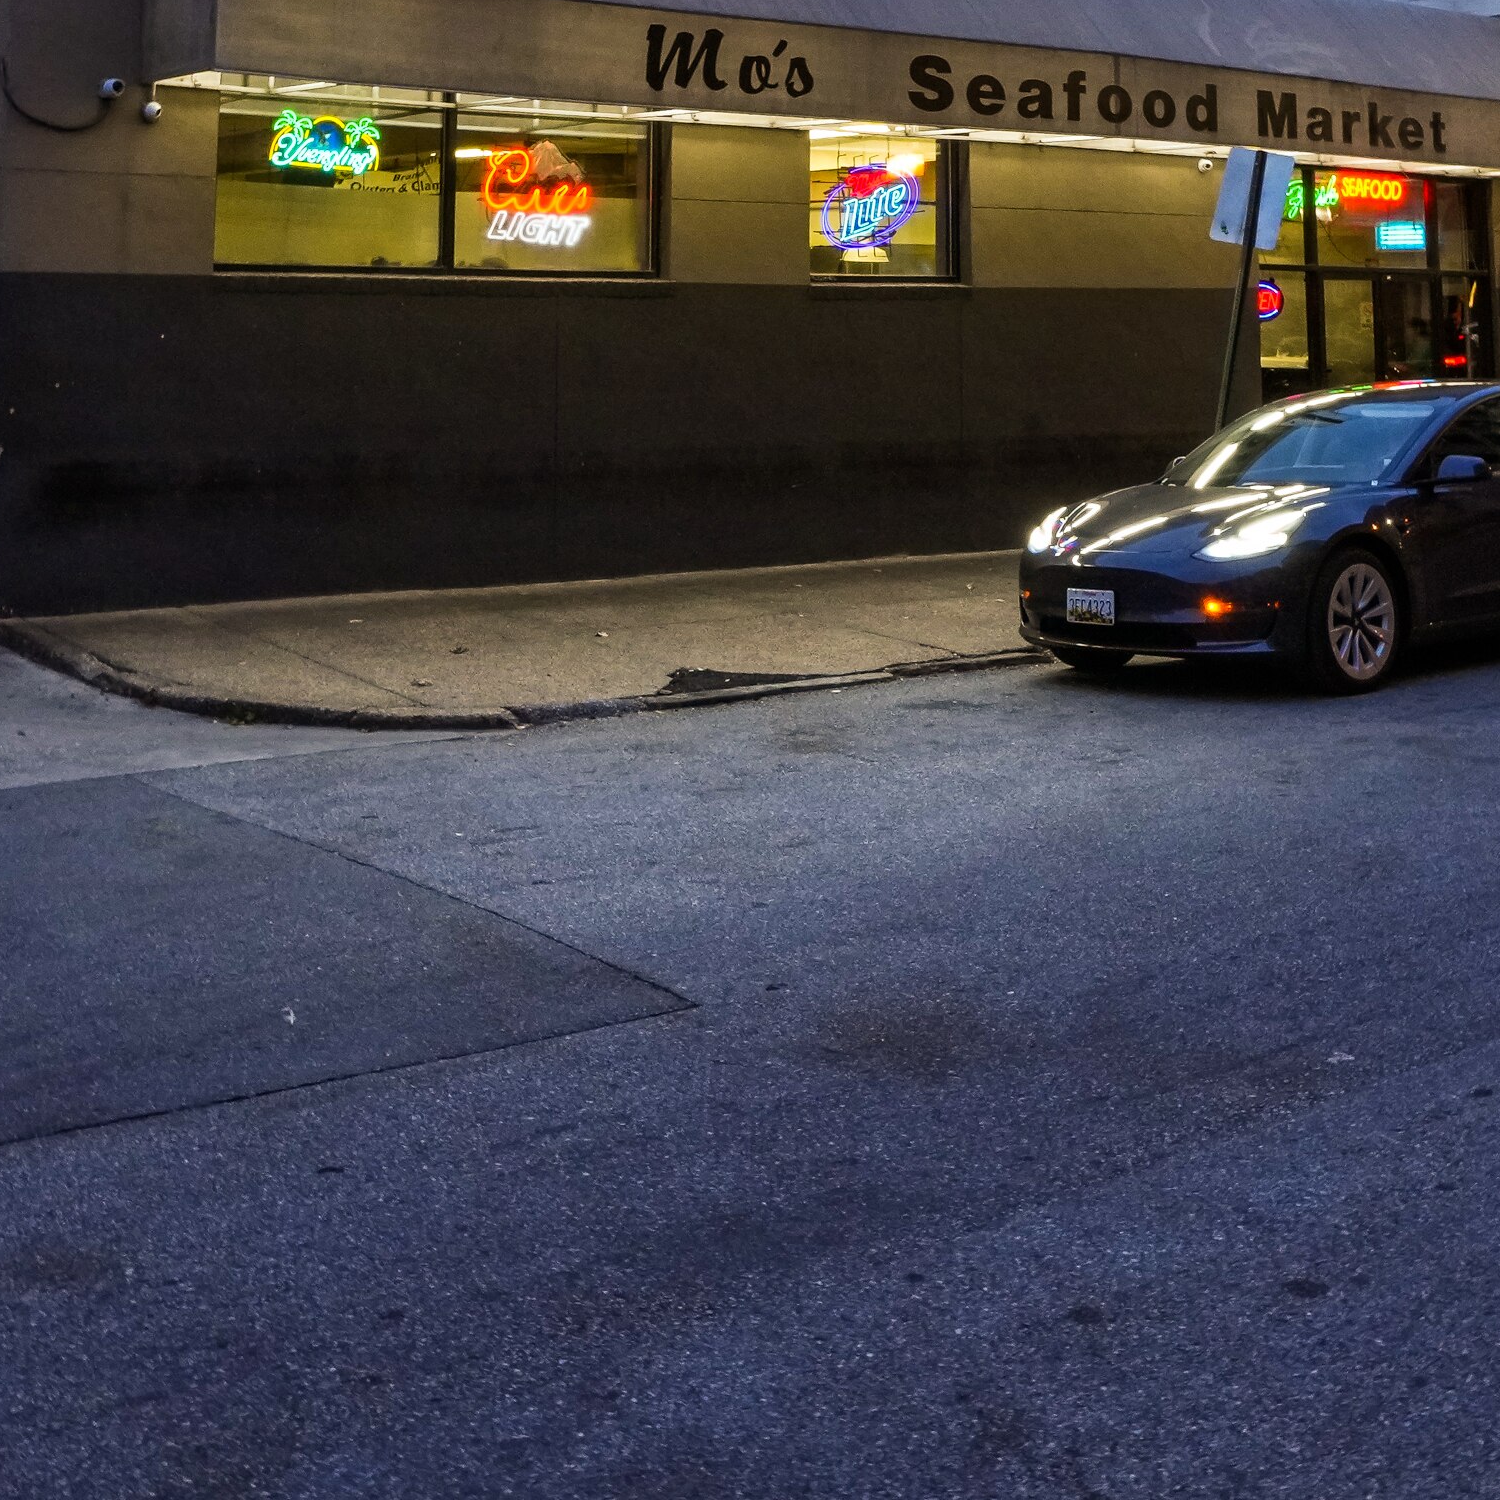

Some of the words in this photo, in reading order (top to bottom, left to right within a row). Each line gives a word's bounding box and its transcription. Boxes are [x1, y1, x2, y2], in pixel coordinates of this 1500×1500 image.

[646, 23, 815, 99] Mo's
[907, 54, 1219, 133] Seafood
[1256, 89, 1447, 153] Market
[272, 132, 377, 175] Yuengling
[398, 183, 408, 193] &
[1341, 176, 1403, 201] SEAFOOD
[486, 210, 592, 246] LIGHT
[840, 183, 906, 242] Lite
[1258, 291, 1279, 310] EN
